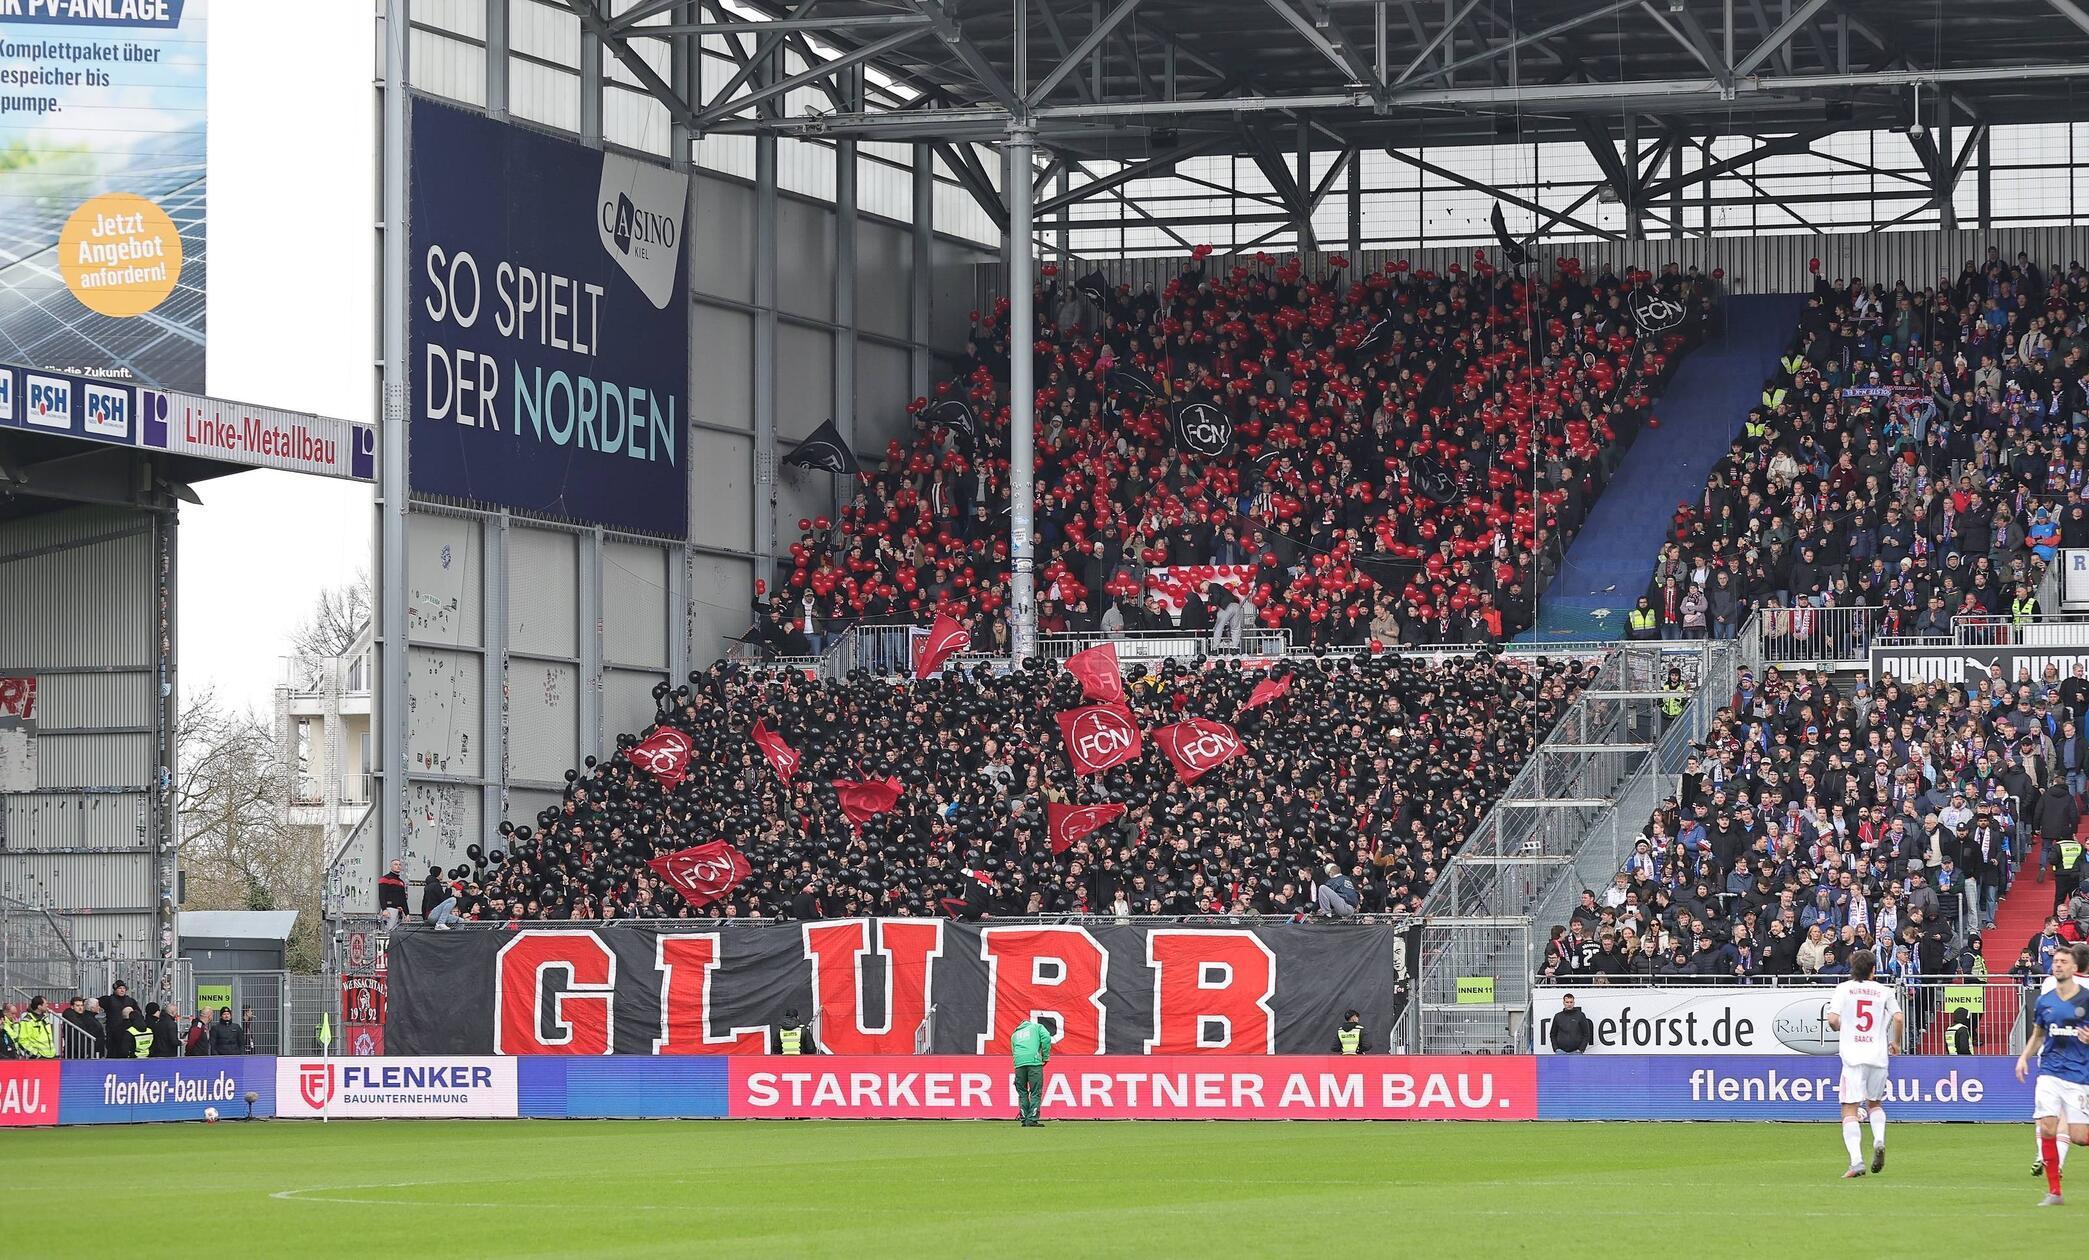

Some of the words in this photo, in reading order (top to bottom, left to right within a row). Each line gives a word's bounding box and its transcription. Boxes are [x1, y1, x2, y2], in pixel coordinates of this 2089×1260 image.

[29, 0, 170, 21] PV-ANLAGE
[123, 43, 160, 62] über
[1, 67, 81, 87] espeicher
[86, 68, 110, 86] bis
[1, 96, 62, 115] pumpe.
[92, 212, 144, 237] Jetzt
[603, 201, 675, 248] CASINO
[79, 236, 164, 264] Angebot
[635, 247, 649, 260] KIEL
[81, 263, 167, 288] anfordern!
[426, 245, 481, 328] SO
[495, 261, 604, 356] SPIELT
[1636, 301, 1682, 325] FCN
[84, 366, 132, 378] Zukunft.
[31, 384, 67, 413] RSH
[89, 393, 124, 422] RSH
[427, 343, 500, 431] DER
[514, 359, 675, 468] NORDEN
[1195, 407, 1209, 423] 1.
[186, 407, 335, 464] Linke-Metallbau
[1186, 424, 1225, 443] FCN
[1883, 657, 1964, 684] PUMA
[1089, 713, 1107, 730] 1.
[1079, 728, 1130, 759] FCN
[1182, 732, 1236, 765] FCN
[680, 856, 731, 889] FCN
[199, 994, 223, 1002] INNEN
[494, 917, 1277, 1055] GLUBB
[1541, 1007, 1754, 1047] reforst.de
[1856, 1000, 1873, 1032] 5
[104, 1071, 235, 1105] flenker-bau.de
[344, 1067, 492, 1088] FLENKER
[747, 1072, 992, 1107] STARKER
[1279, 1073, 1365, 1107] AM
[1382, 1073, 1510, 1108] BAU.
[1689, 1069, 1984, 1103] flenker-au.de
[0, 1078, 47, 1114] AU.
[344, 1094, 468, 1104] BAUUNTERNEHMUNG
